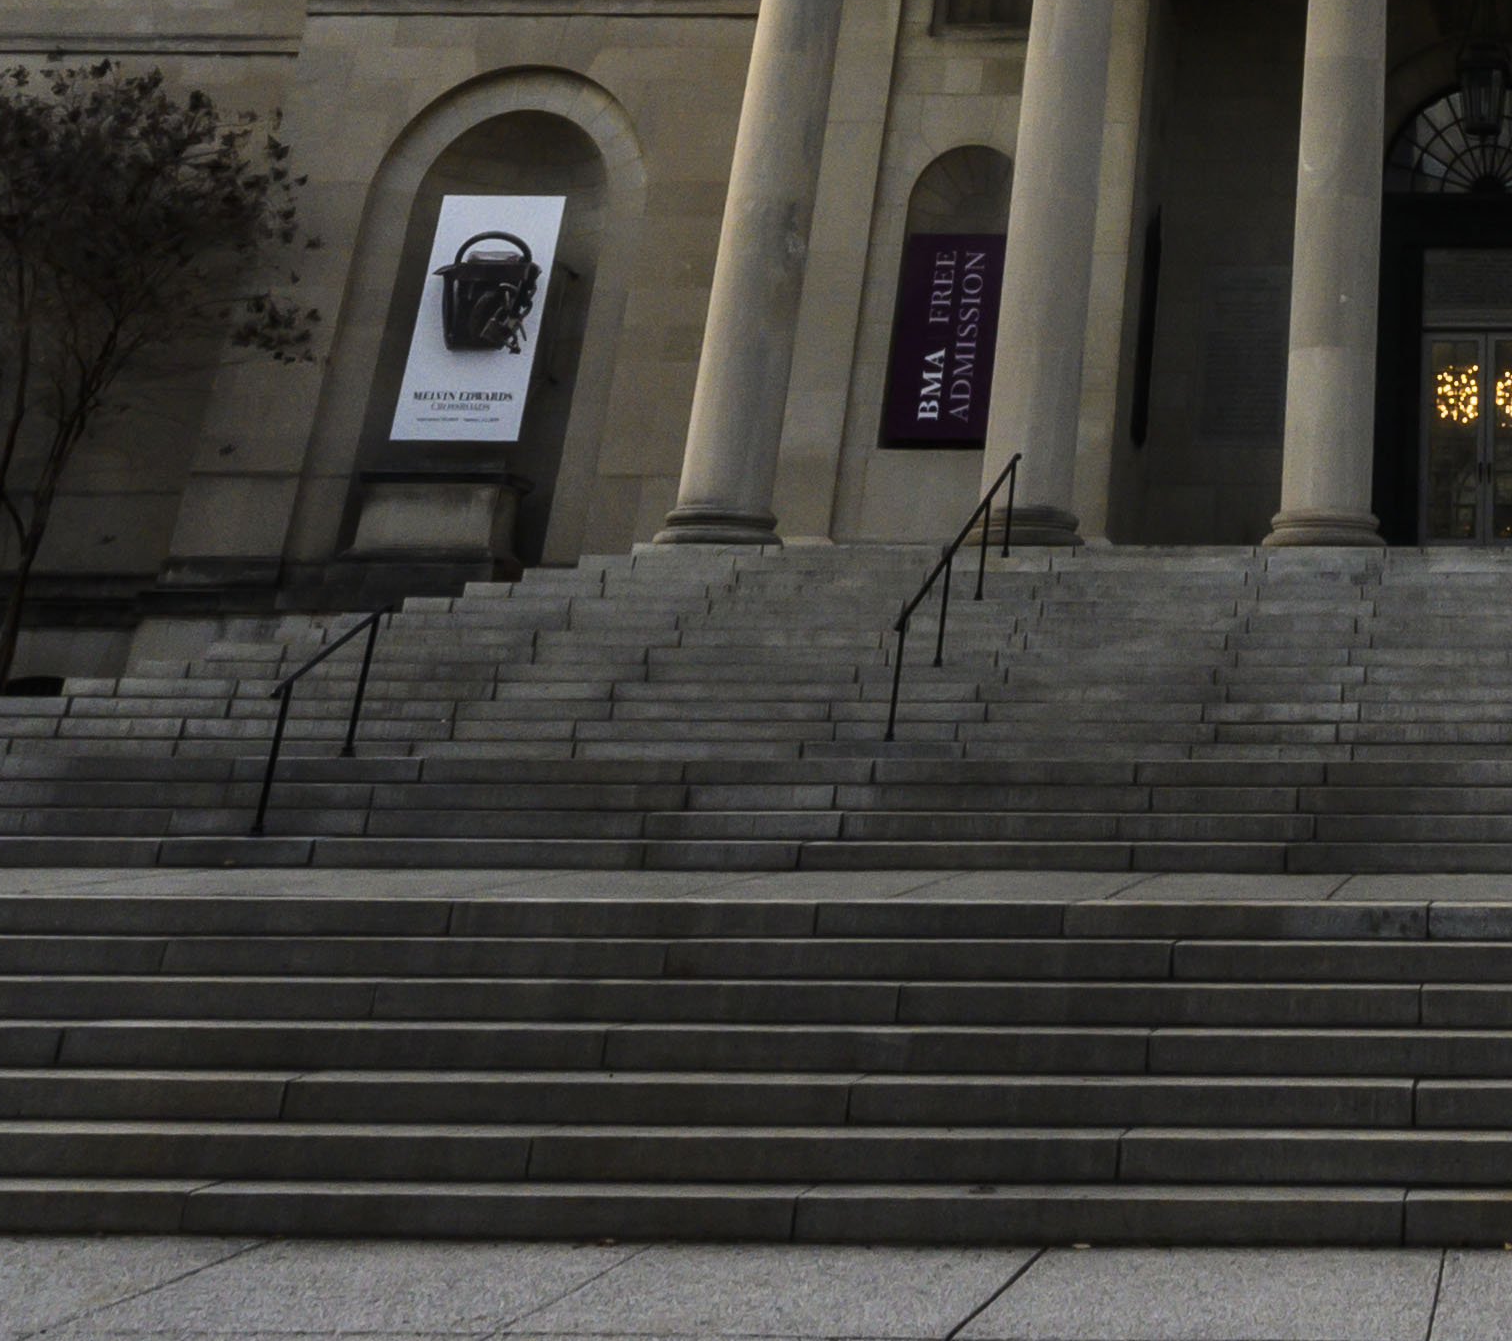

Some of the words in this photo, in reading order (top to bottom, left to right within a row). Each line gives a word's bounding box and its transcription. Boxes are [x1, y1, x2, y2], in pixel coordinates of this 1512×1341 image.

[929, 251, 957, 325] FREE
[949, 252, 986, 422] ADMISSION
[413, 391, 456, 401] MELVIN
[458, 391, 513, 402] EDWARDS
[917, 348, 946, 421] BMA
